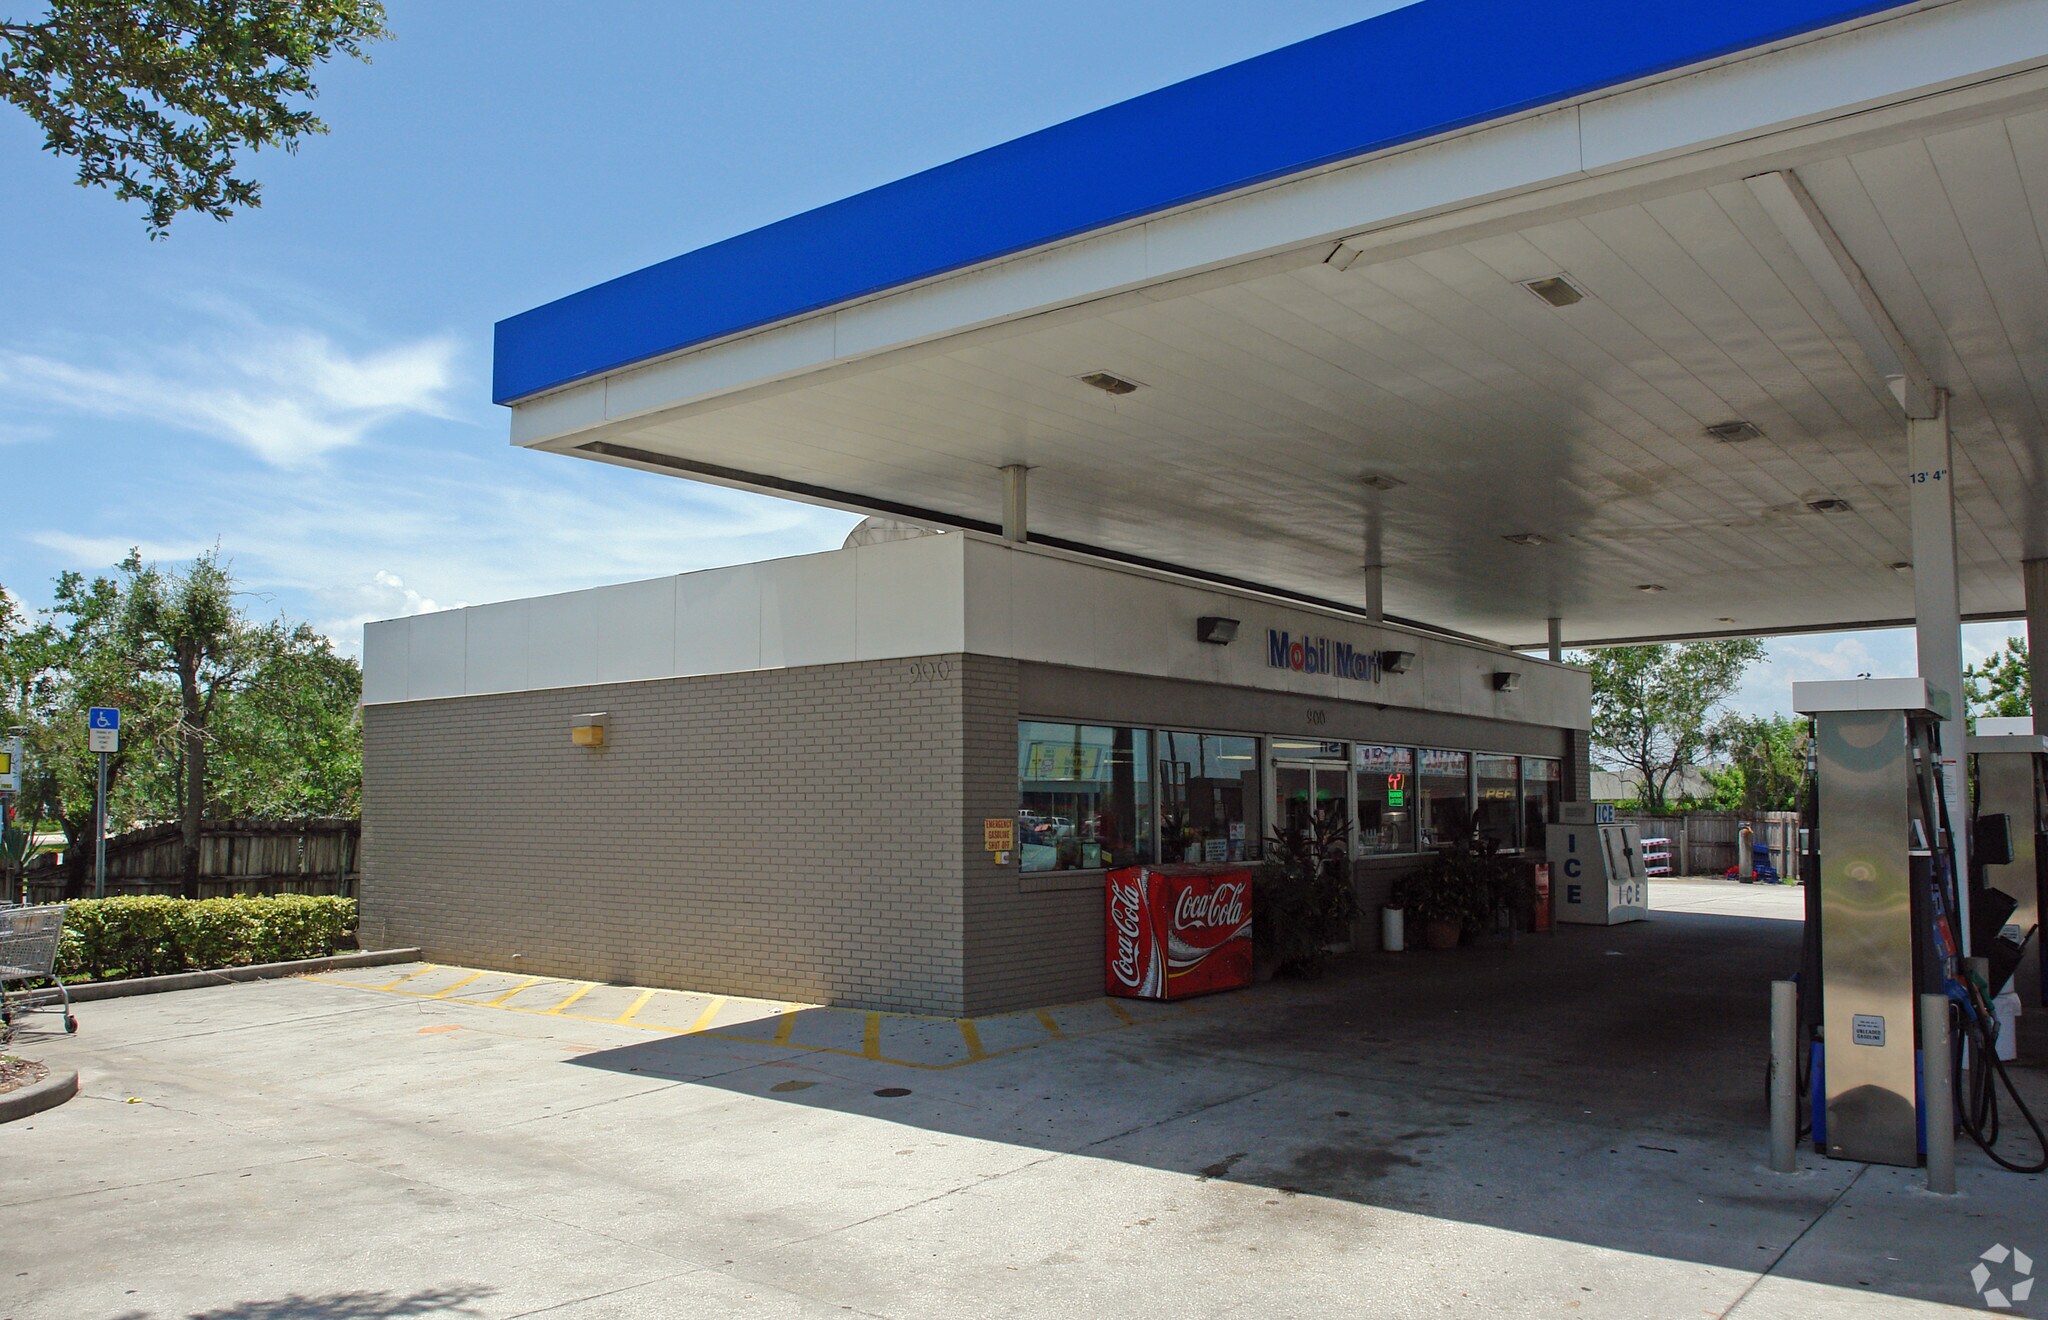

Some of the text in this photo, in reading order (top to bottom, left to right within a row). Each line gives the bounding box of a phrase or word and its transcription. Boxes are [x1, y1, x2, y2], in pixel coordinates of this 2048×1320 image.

[1267, 628, 1382, 683] Mobil Mart
[910, 661, 950, 683] 900
[1306, 709, 1326, 725] 900
[1598, 805, 1613, 822] ICE
[986, 820, 1011, 829] EMERGENCY
[988, 830, 1010, 839] GASOLINE
[988, 840, 1010, 849] SHUT OFF
[1564, 834, 1581, 904] ICE
[1618, 884, 1640, 905] ICE
